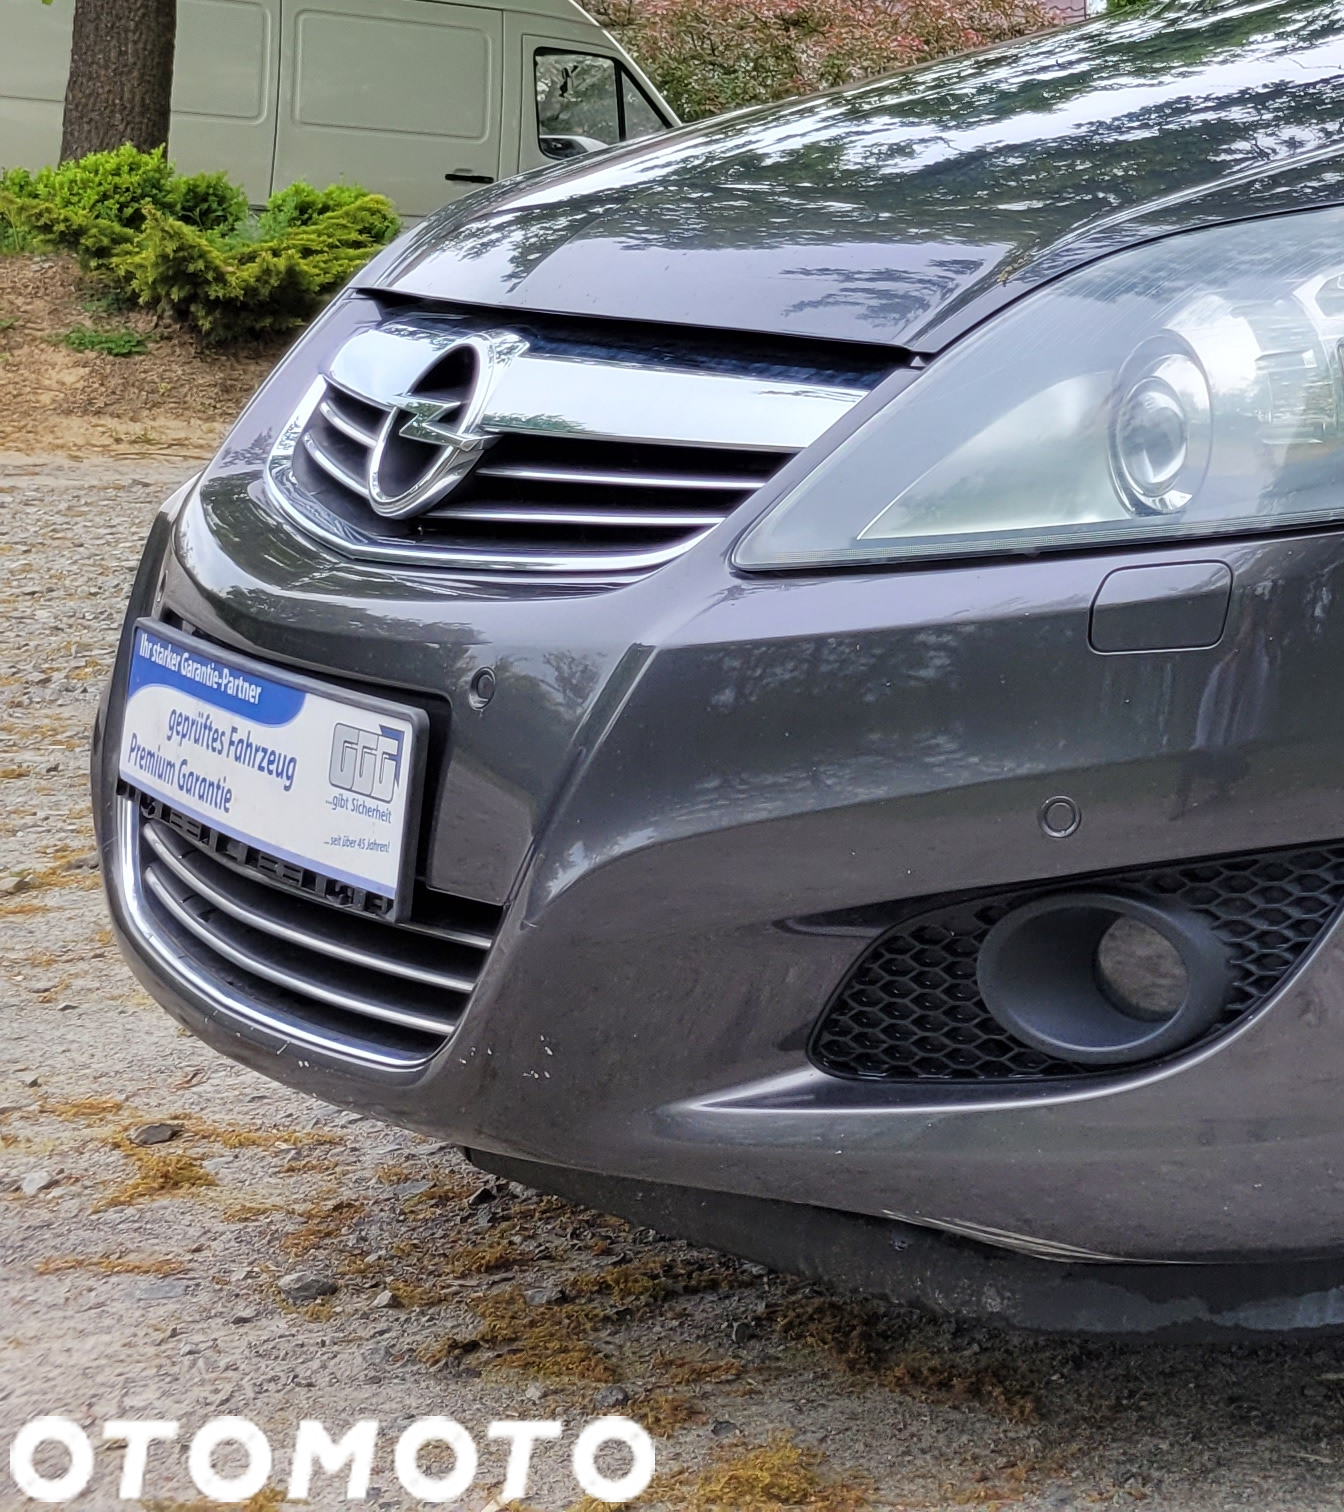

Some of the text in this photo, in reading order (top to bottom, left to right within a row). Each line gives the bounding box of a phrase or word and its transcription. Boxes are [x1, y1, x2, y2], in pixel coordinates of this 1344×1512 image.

[139, 633, 262, 704] Ihr starker Garantie-Partner
[128, 732, 233, 813] Premium Garantie
[167, 709, 297, 792] geprüftes Fahrzeug
[342, 835, 357, 849] über
[357, 837, 366, 849] 45
[366, 840, 390, 853] Jahren!
[351, 798, 392, 824] Sicherheit
